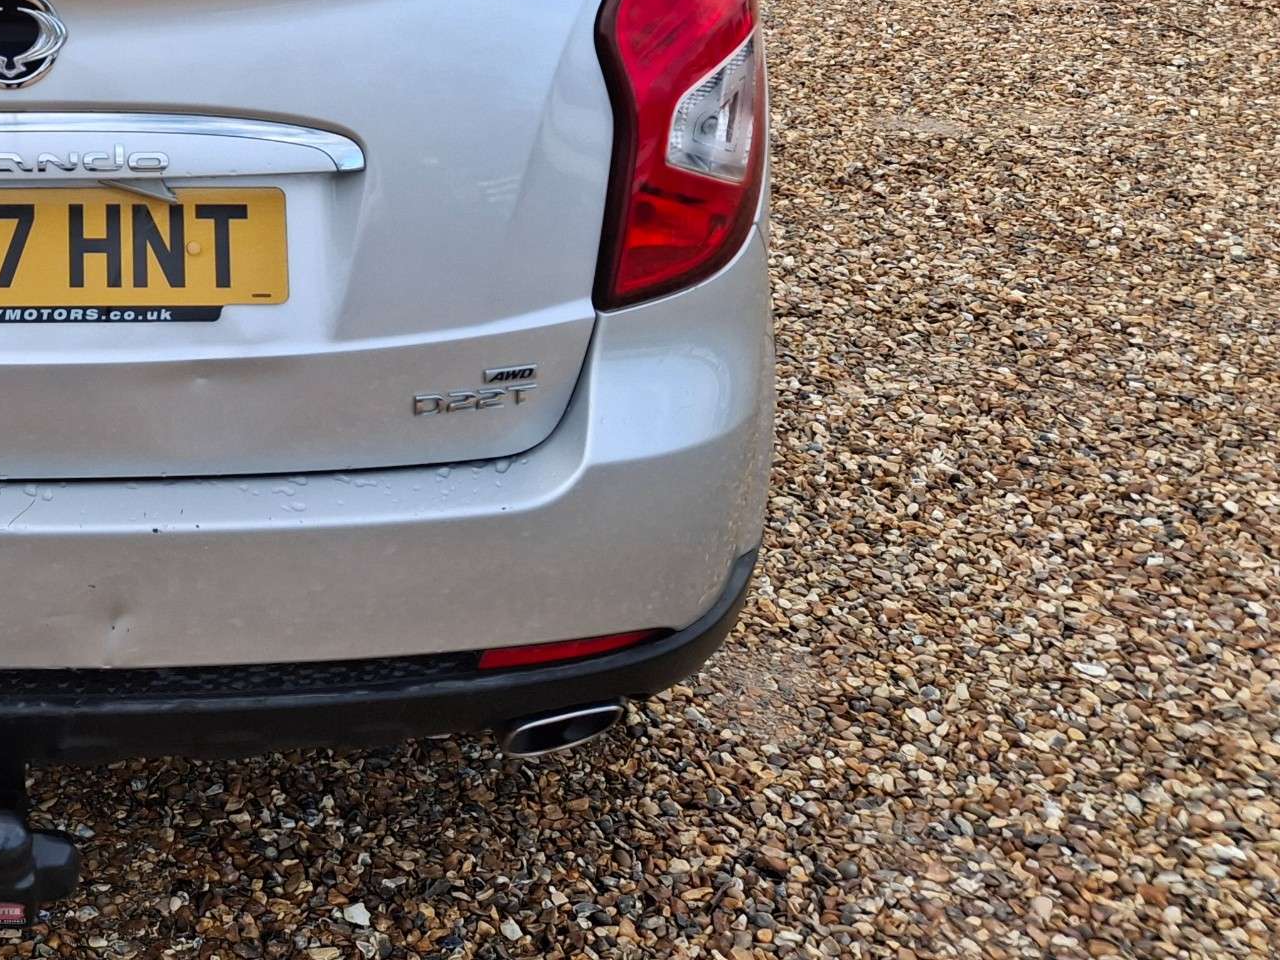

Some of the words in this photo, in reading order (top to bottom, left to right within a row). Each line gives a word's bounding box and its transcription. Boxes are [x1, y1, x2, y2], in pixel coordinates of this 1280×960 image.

[68, 204, 248, 289] HNT
[488, 368, 535, 383] AWD
[414, 383, 538, 416] D22T
